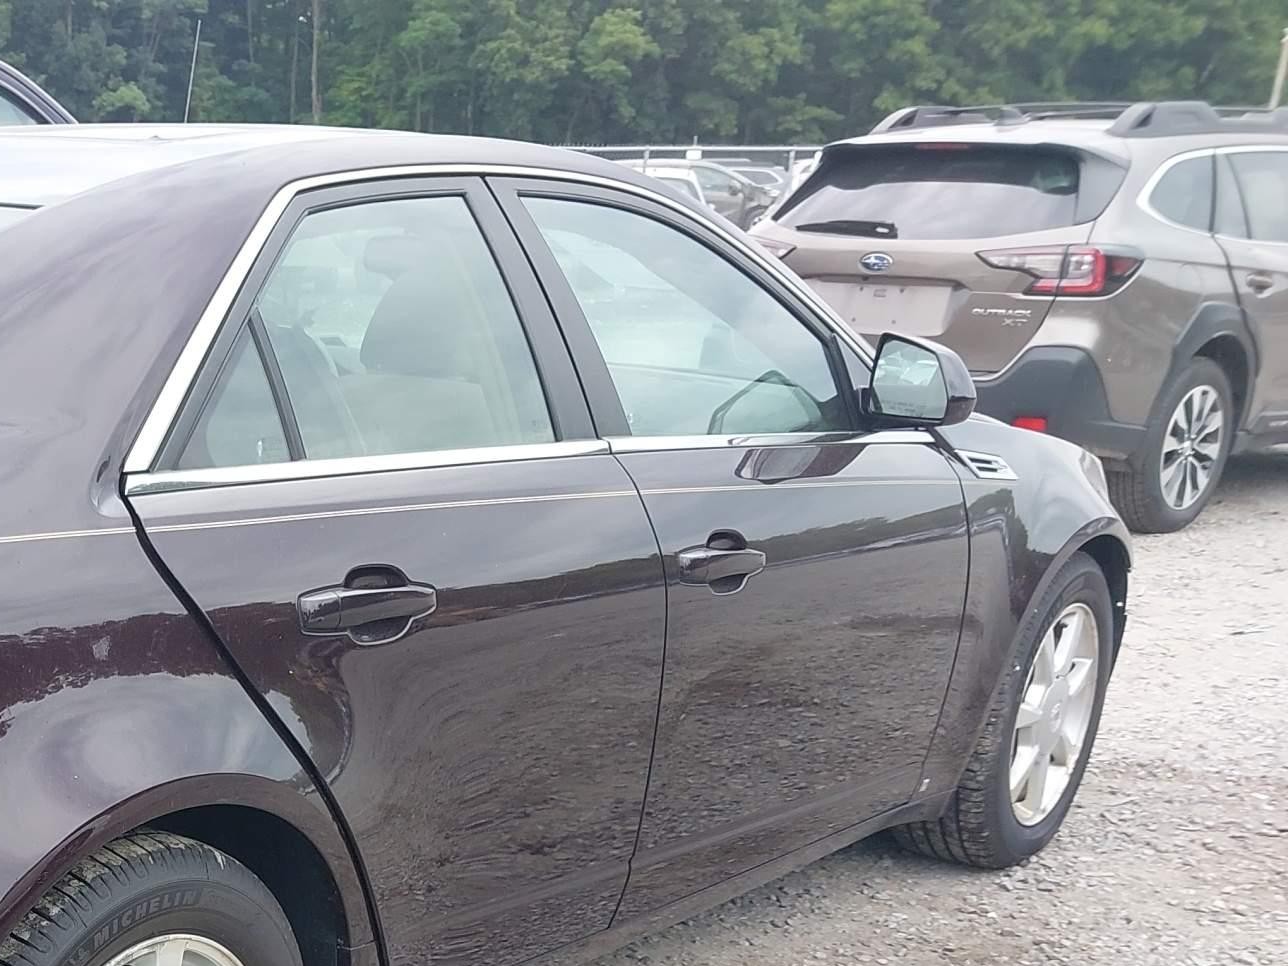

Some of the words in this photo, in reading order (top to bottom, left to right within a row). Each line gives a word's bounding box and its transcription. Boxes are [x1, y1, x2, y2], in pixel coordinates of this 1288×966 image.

[972, 307, 1032, 318] OUTBACK
[1001, 318, 1029, 327] XT
[93, 890, 200, 949] MICHELIN
